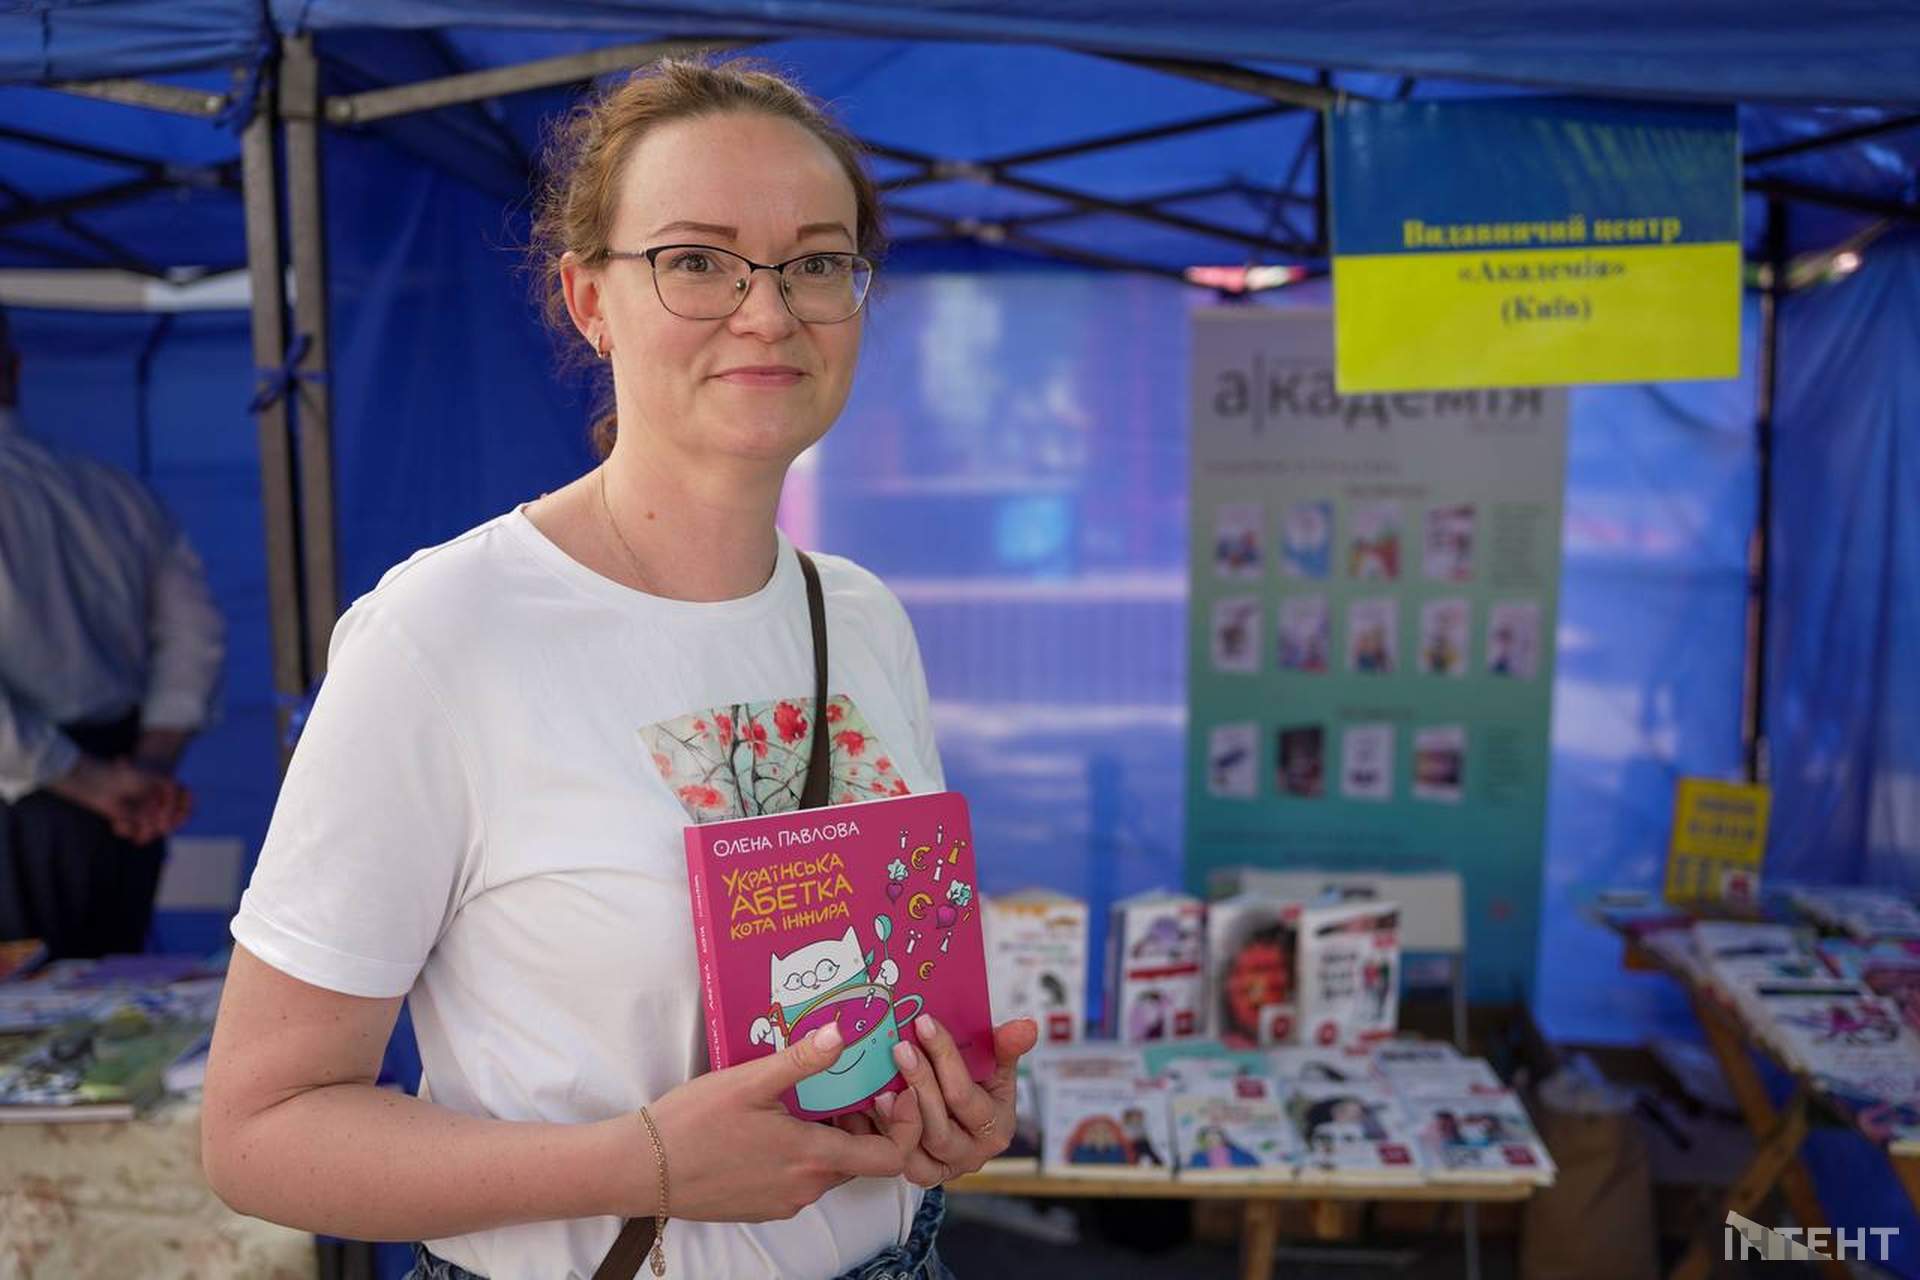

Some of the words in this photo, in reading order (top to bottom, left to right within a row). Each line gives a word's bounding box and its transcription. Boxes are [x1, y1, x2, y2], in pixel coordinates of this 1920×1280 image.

[1403, 214, 1586, 248] Видавничий
[1594, 216, 1681, 244] центр
[1502, 295, 1592, 324] (Київ)
[713, 836, 773, 857] ОЛЕНА
[778, 821, 860, 847] ПАВЛОВА
[721, 852, 845, 897] УКРАЇНСЬКА
[731, 873, 853, 921] АБЕТКА
[730, 917, 776, 941] КОТА
[782, 901, 850, 931] ІНЖИРА
